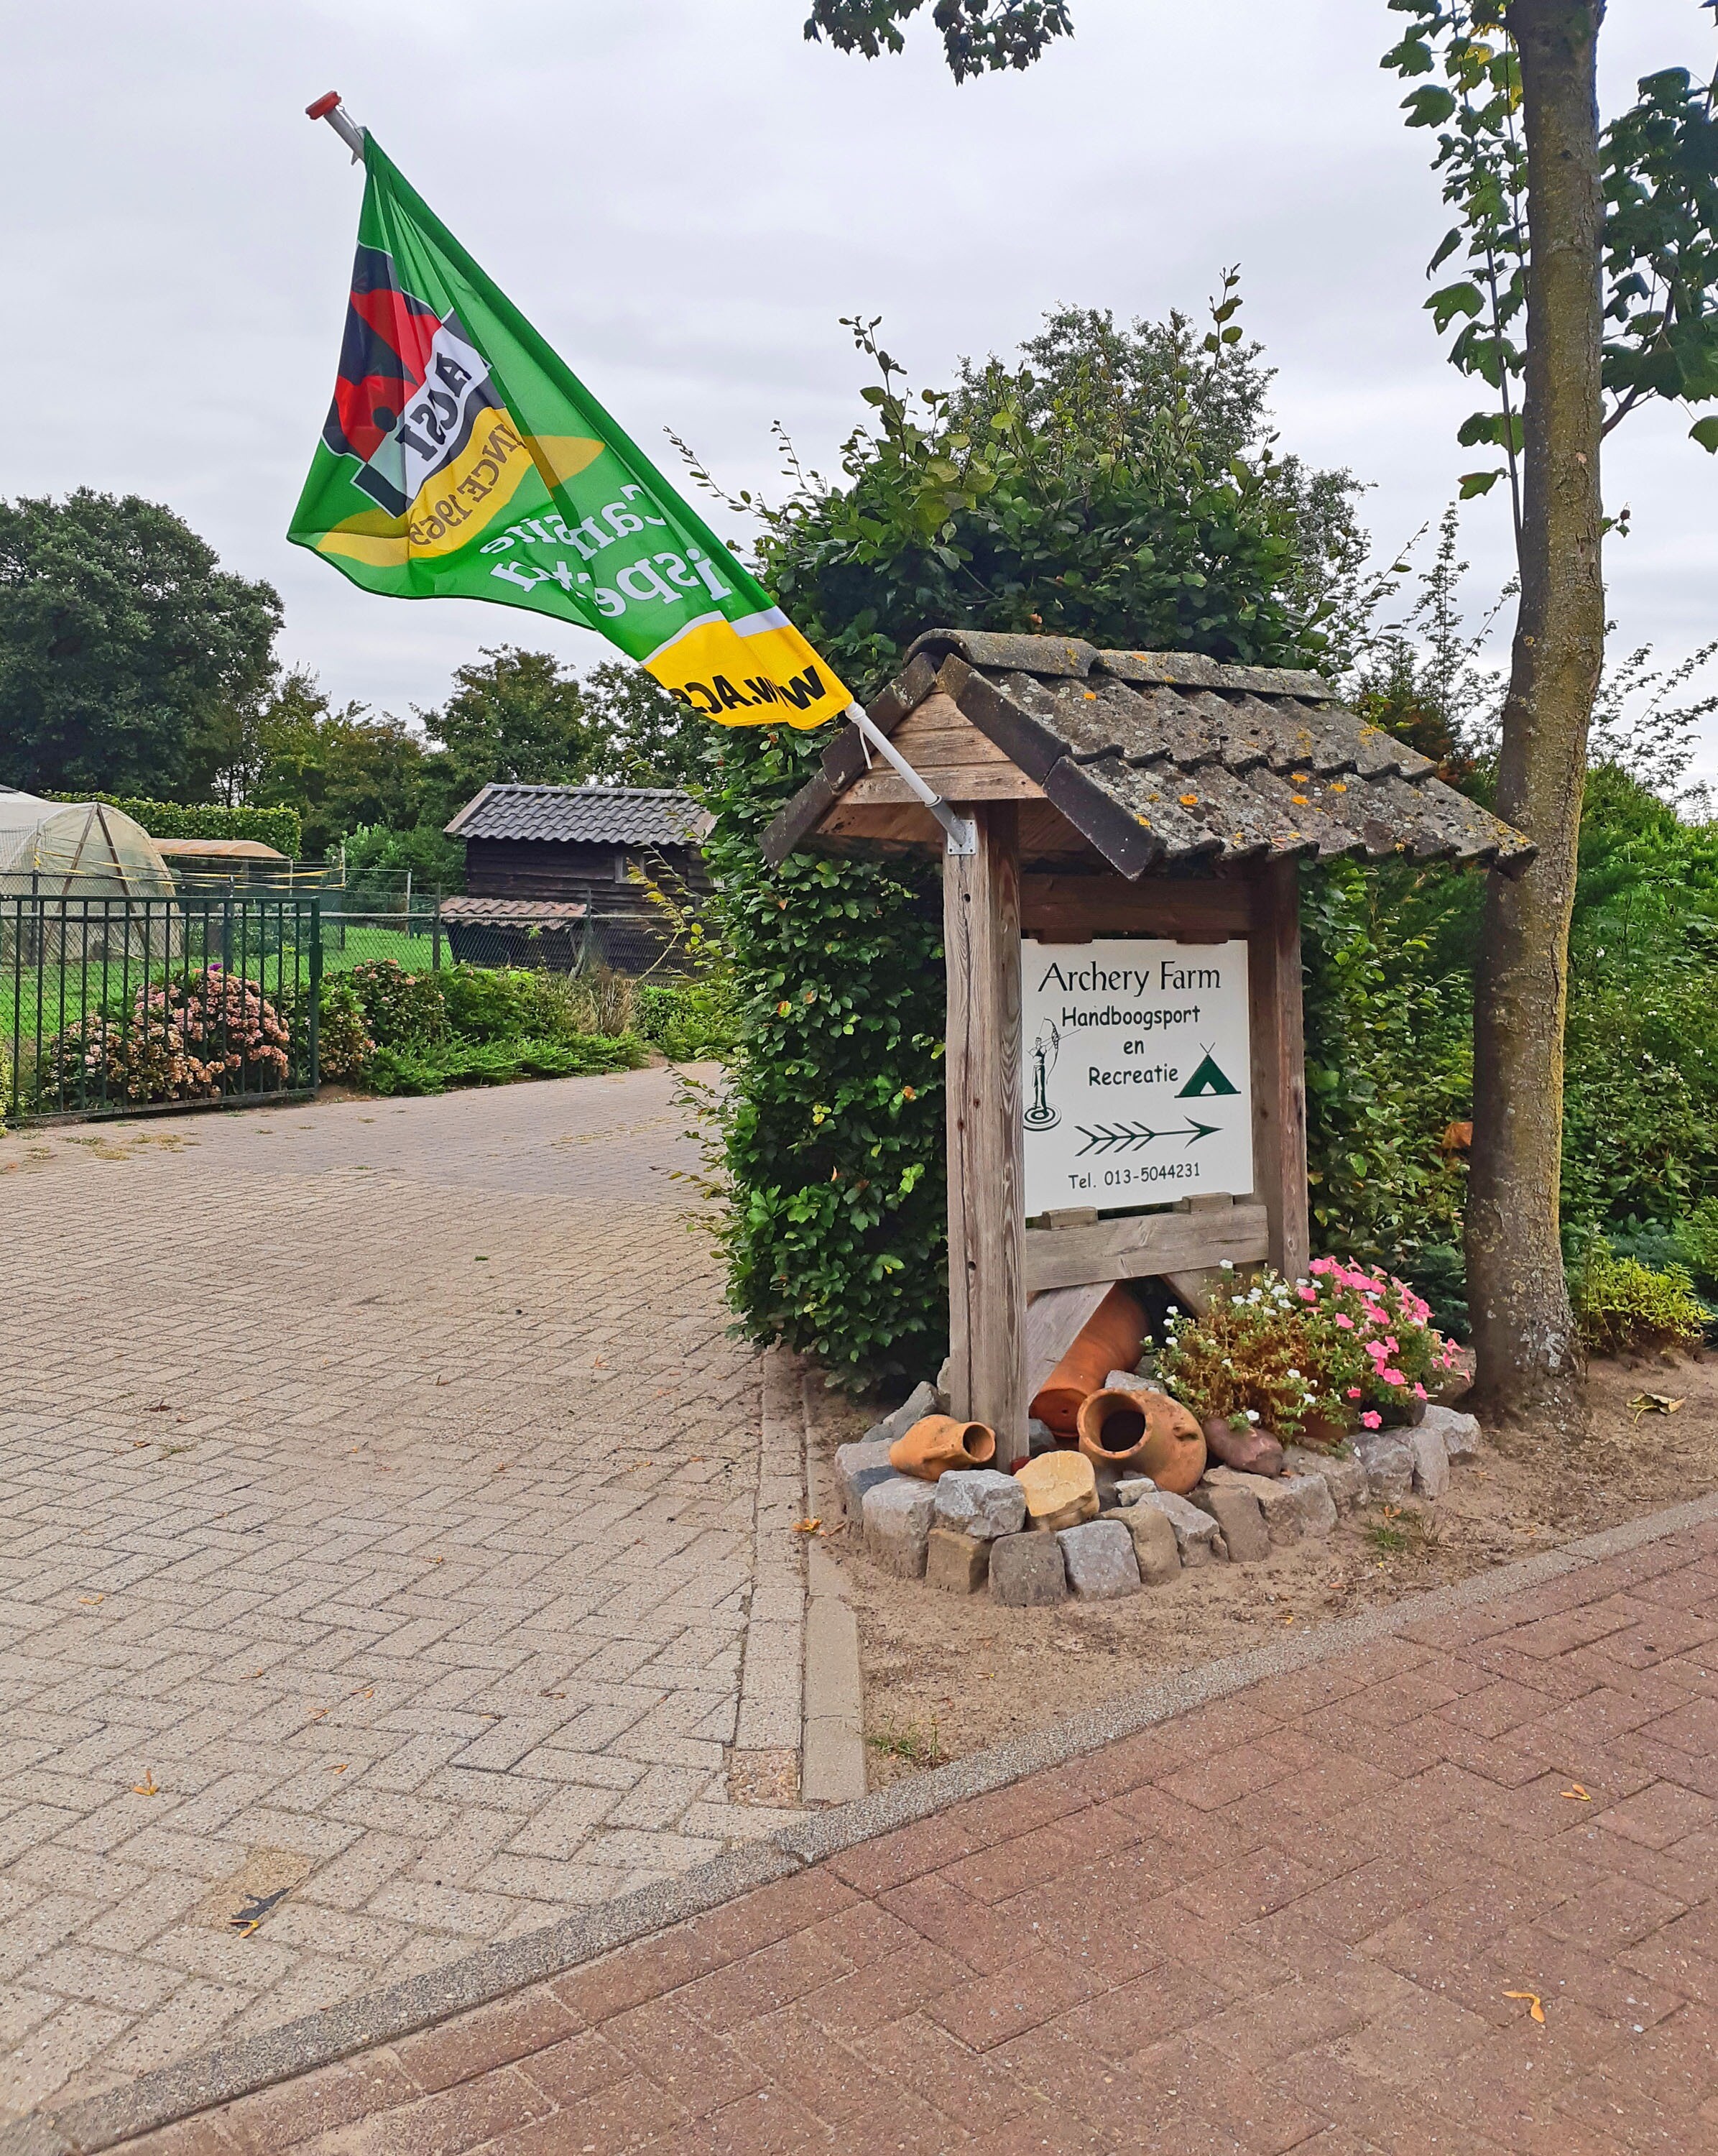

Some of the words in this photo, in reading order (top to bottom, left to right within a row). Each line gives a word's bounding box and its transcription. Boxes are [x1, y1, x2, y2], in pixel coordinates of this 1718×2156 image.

[1038, 961, 1150, 998] Archery
[1160, 960, 1221, 990] Farm
[1061, 1005, 1201, 1031] Handboogsport
[1123, 1037, 1145, 1055] en
[1089, 1063, 1179, 1087] Recreatie
[1068, 1174, 1096, 1189] Tel.
[1104, 1162, 1201, 1187] 013-5044231
